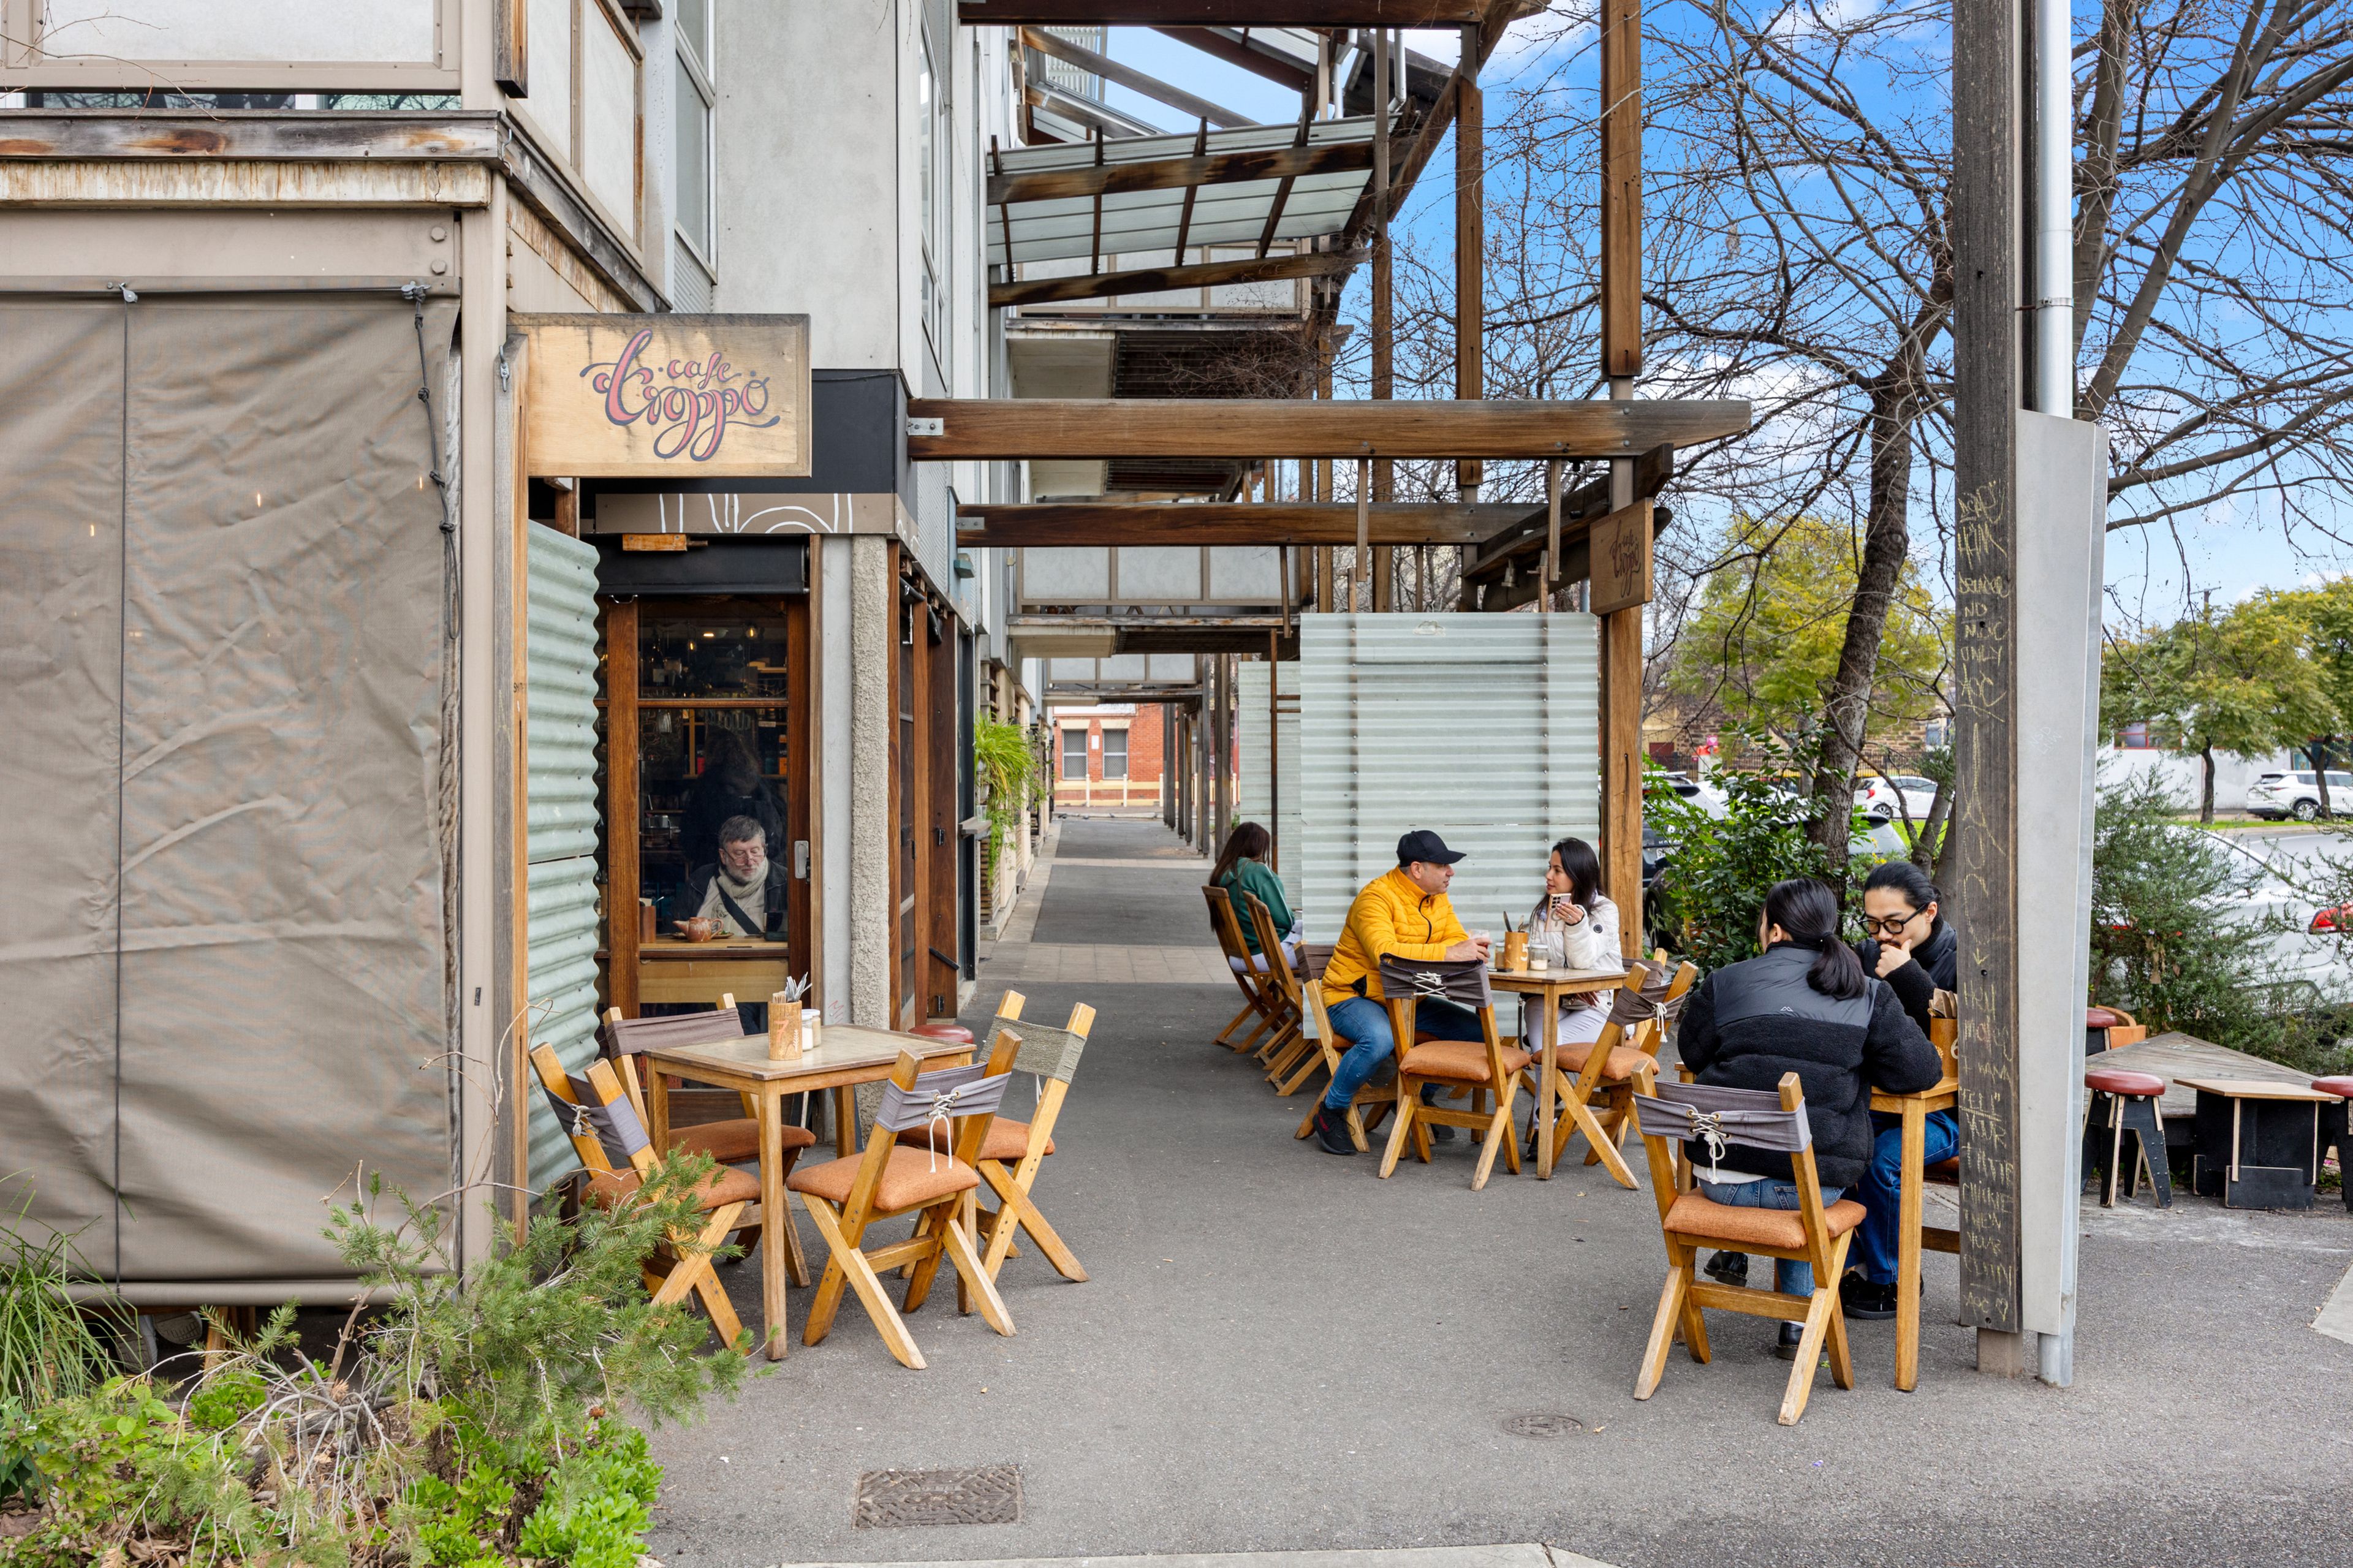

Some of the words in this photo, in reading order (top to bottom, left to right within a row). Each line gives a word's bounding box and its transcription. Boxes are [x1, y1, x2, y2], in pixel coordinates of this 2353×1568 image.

[667, 351, 742, 390] cafe
[1520, 942, 1529, 961] 5
[774, 1020, 789, 1043] 7
